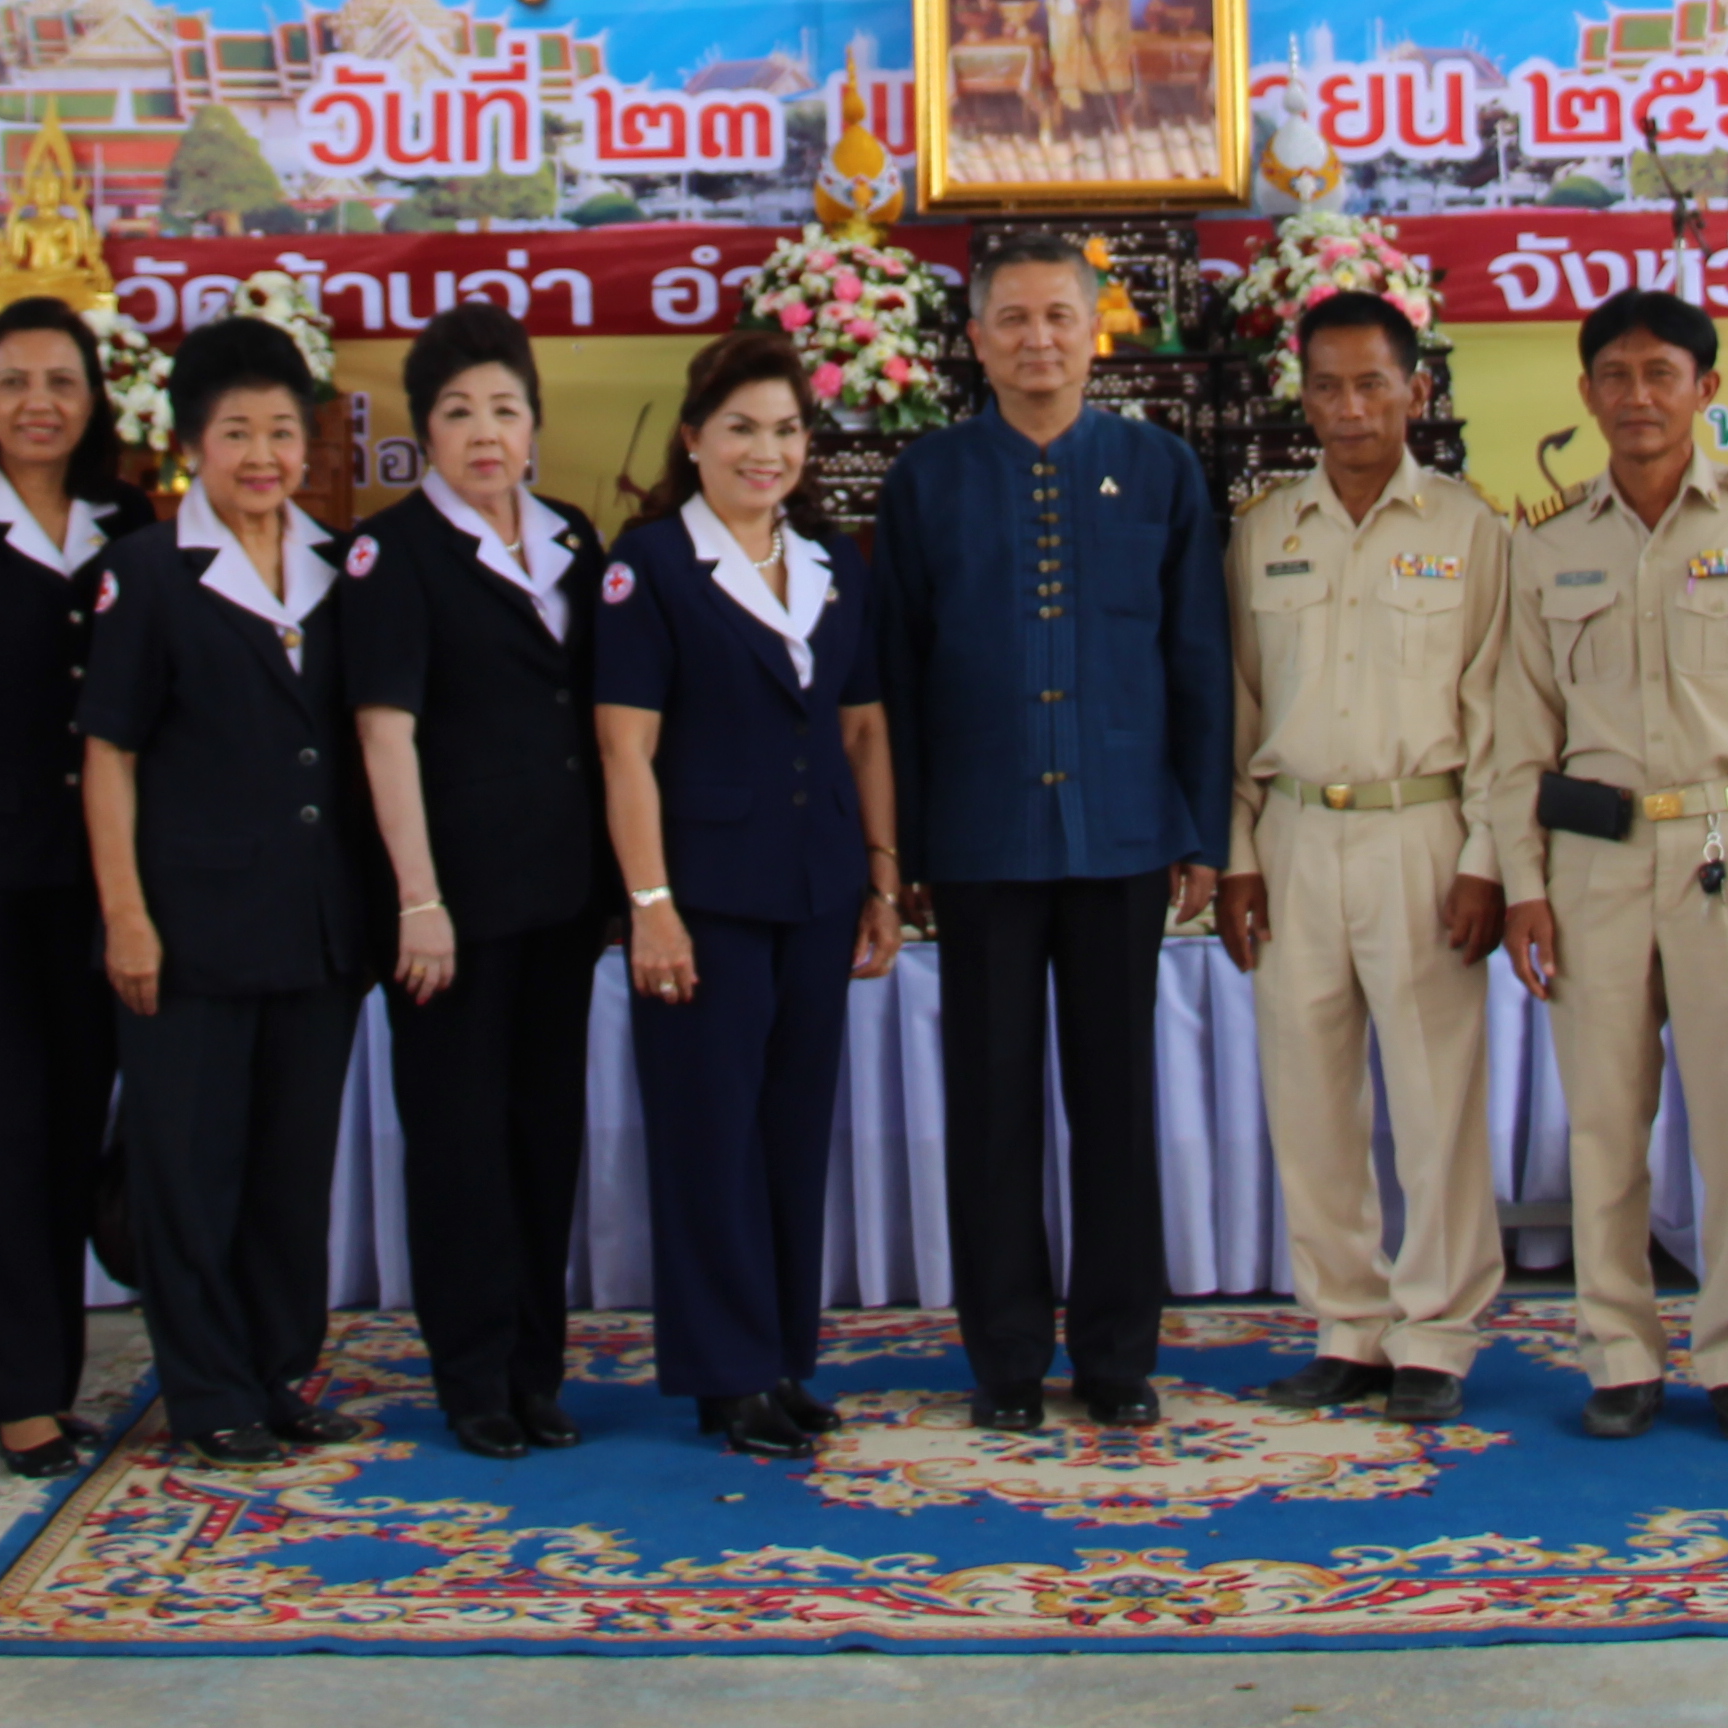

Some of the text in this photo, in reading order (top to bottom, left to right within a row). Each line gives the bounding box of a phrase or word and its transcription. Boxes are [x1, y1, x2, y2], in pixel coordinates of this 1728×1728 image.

[309, 42, 530, 166] วันที่
[589, 86, 774, 161] ๒๓
